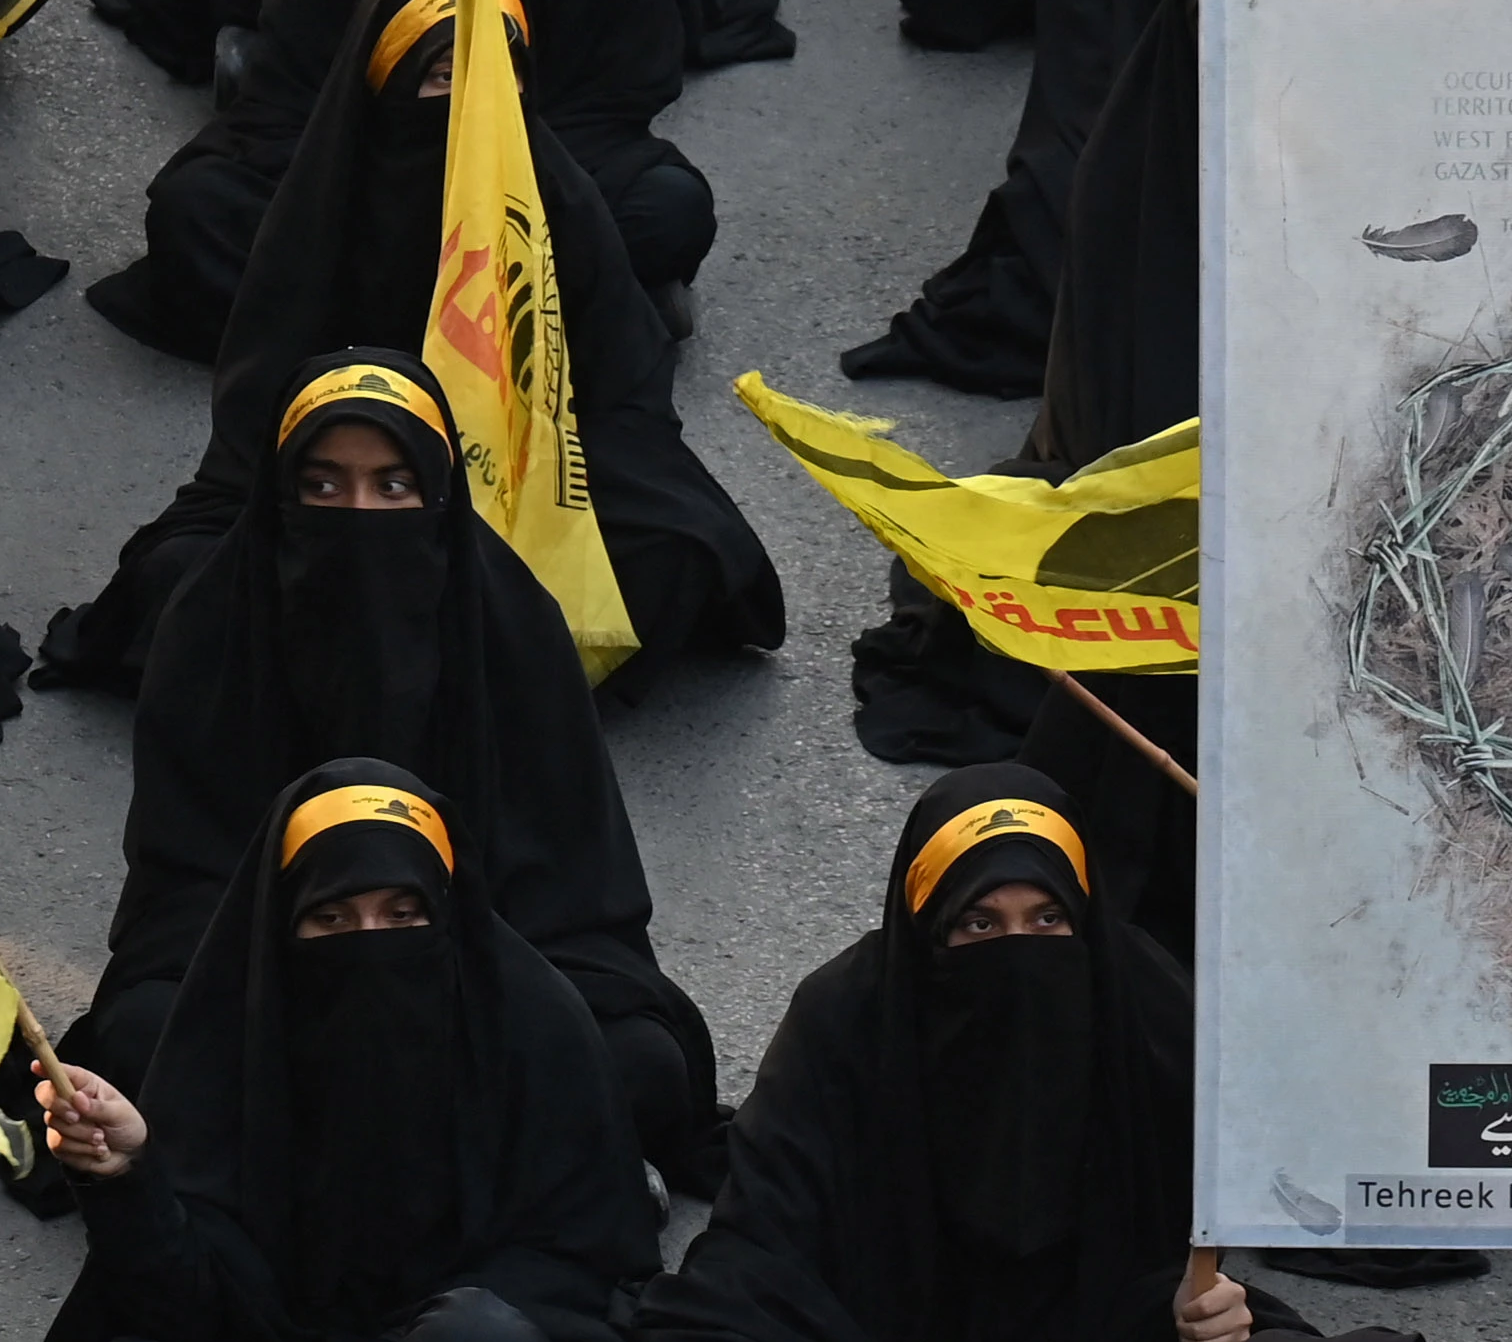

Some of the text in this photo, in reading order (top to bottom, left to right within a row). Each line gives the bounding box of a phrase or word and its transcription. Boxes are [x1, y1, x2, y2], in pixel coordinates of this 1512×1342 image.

[1435, 130, 1495, 149] WEST
[1435, 162, 1484, 181] GAZA
[1358, 1181, 1496, 1211] Tehreek
